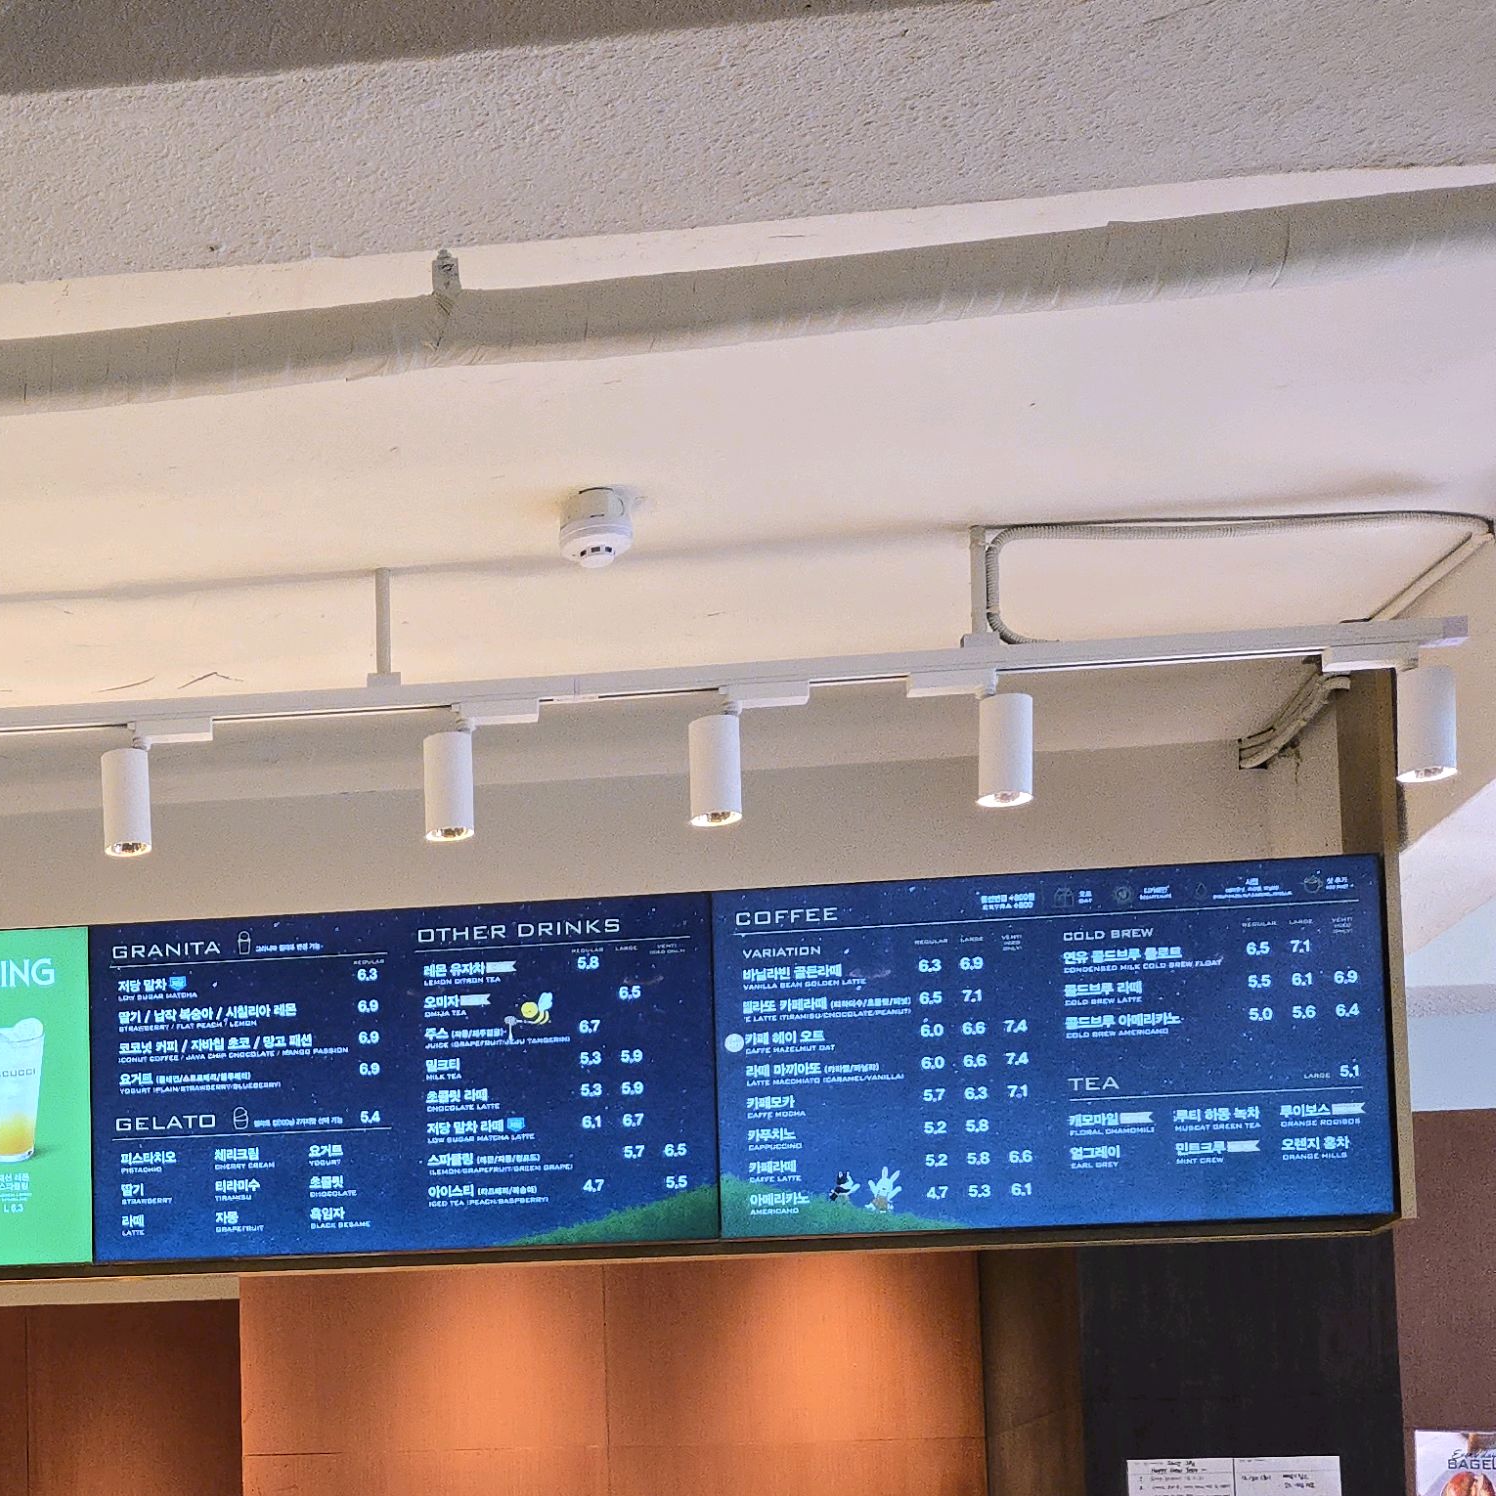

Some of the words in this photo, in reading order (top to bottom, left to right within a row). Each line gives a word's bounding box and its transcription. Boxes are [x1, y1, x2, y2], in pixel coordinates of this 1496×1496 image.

[736, 908, 838, 926] COFFEE
[1242, 920, 1276, 928] REGULAR
[418, 925, 506, 943] OTHER
[518, 919, 620, 937] DRINKS
[1063, 930, 1105, 941] COLD
[1111, 928, 1153, 939] BREW
[113, 941, 220, 959] GRANITA
[743, 946, 820, 959] VARIATION
[1247, 941, 1270, 956] 6.5
[1290, 939, 1310, 953] 7.1
[578, 957, 599, 969] 5.8
[919, 959, 941, 973] 6.3
[960, 957, 983, 970] 6.9
[357, 968, 378, 981] 6.3
[424, 964, 447, 977] 레몬
[743, 967, 790, 981] 바닐라빈
[1334, 970, 1358, 984] 6.9
[118, 979, 140, 992] 저당
[1248, 975, 1271, 989] 5.5
[1292, 973, 1312, 986] 6.1
[619, 986, 640, 998] 6.5
[919, 991, 942, 1005] 6.5
[961, 989, 982, 1003] 7.1
[358, 1000, 378, 1013] 6.9
[424, 995, 459, 1008] 오미자
[780, 997, 827, 1011] 카페라떼
[1249, 1007, 1272, 1022] 5.0
[1292, 1005, 1316, 1019] 5.6
[1336, 1003, 1360, 1017] 6.4
[580, 1020, 600, 1033] 6.7
[921, 1024, 943, 1037] 6.0
[961, 1022, 985, 1034] 6.6
[1003, 1020, 1028, 1033] 7.4
[359, 1031, 379, 1044] 6.9
[425, 1028, 448, 1040] 주스
[580, 1052, 601, 1064] 5.3
[621, 1050, 643, 1063] 5.9
[921, 1056, 944, 1070] 6.0
[963, 1054, 987, 1068] 6.6
[1005, 1052, 1029, 1065] 7.4
[360, 1063, 380, 1075] 6.9
[426, 1058, 461, 1071] 밀크티
[746, 1064, 770, 1077] 라떼
[774, 1062, 821, 1075] 마끼아또
[1340, 1065, 1360, 1078] 5.1
[119, 1073, 153, 1086] 요거트
[1068, 1077, 1119, 1091] TEA
[464, 1088, 487, 1101] 라떼
[581, 1083, 602, 1096] 5.3
[621, 1082, 643, 1095] 5.9
[923, 1088, 945, 1102] 5.7
[965, 1087, 988, 1100] 6.3
[1007, 1084, 1028, 1098] 7.1
[747, 1095, 795, 1108] 카페모카
[1281, 1103, 1330, 1118] 루이보스
[116, 1114, 215, 1131] GELATO
[360, 1111, 380, 1124] 5.4
[582, 1115, 601, 1128] 6.1
[623, 1113, 644, 1127] 6.7
[427, 1122, 450, 1135] 저당
[481, 1119, 504, 1132] 라떼
[924, 1121, 947, 1134] 5.2
[966, 1119, 989, 1132] 5.8
[748, 1127, 795, 1141] 카푸치노
[309, 1144, 343, 1157] 요거트
[664, 1144, 686, 1156] 6.5
[1282, 1138, 1320, 1152] 오렌지
[121, 1151, 176, 1165] 피스타치오
[624, 1146, 644, 1158] 5.7
[967, 1152, 990, 1165] 5.8
[1009, 1150, 1033, 1164] 6.6
[1071, 1145, 1120, 1159] 얼그레이
[749, 1160, 796, 1173] 카페라떼
[925, 1154, 948, 1167] 5.2
[215, 1179, 260, 1192] 티라미수
[583, 1179, 604, 1192] 4.7
[666, 1175, 687, 1188] 5.5
[121, 1183, 143, 1196] 딸기
[428, 1184, 474, 1198] 아이스티
[926, 1186, 948, 1200] 4.7
[968, 1184, 991, 1198] 5.3
[1011, 1183, 1032, 1196] 6.1
[750, 1192, 809, 1206] 아메리카노
[122, 1214, 144, 1228] 라떼
